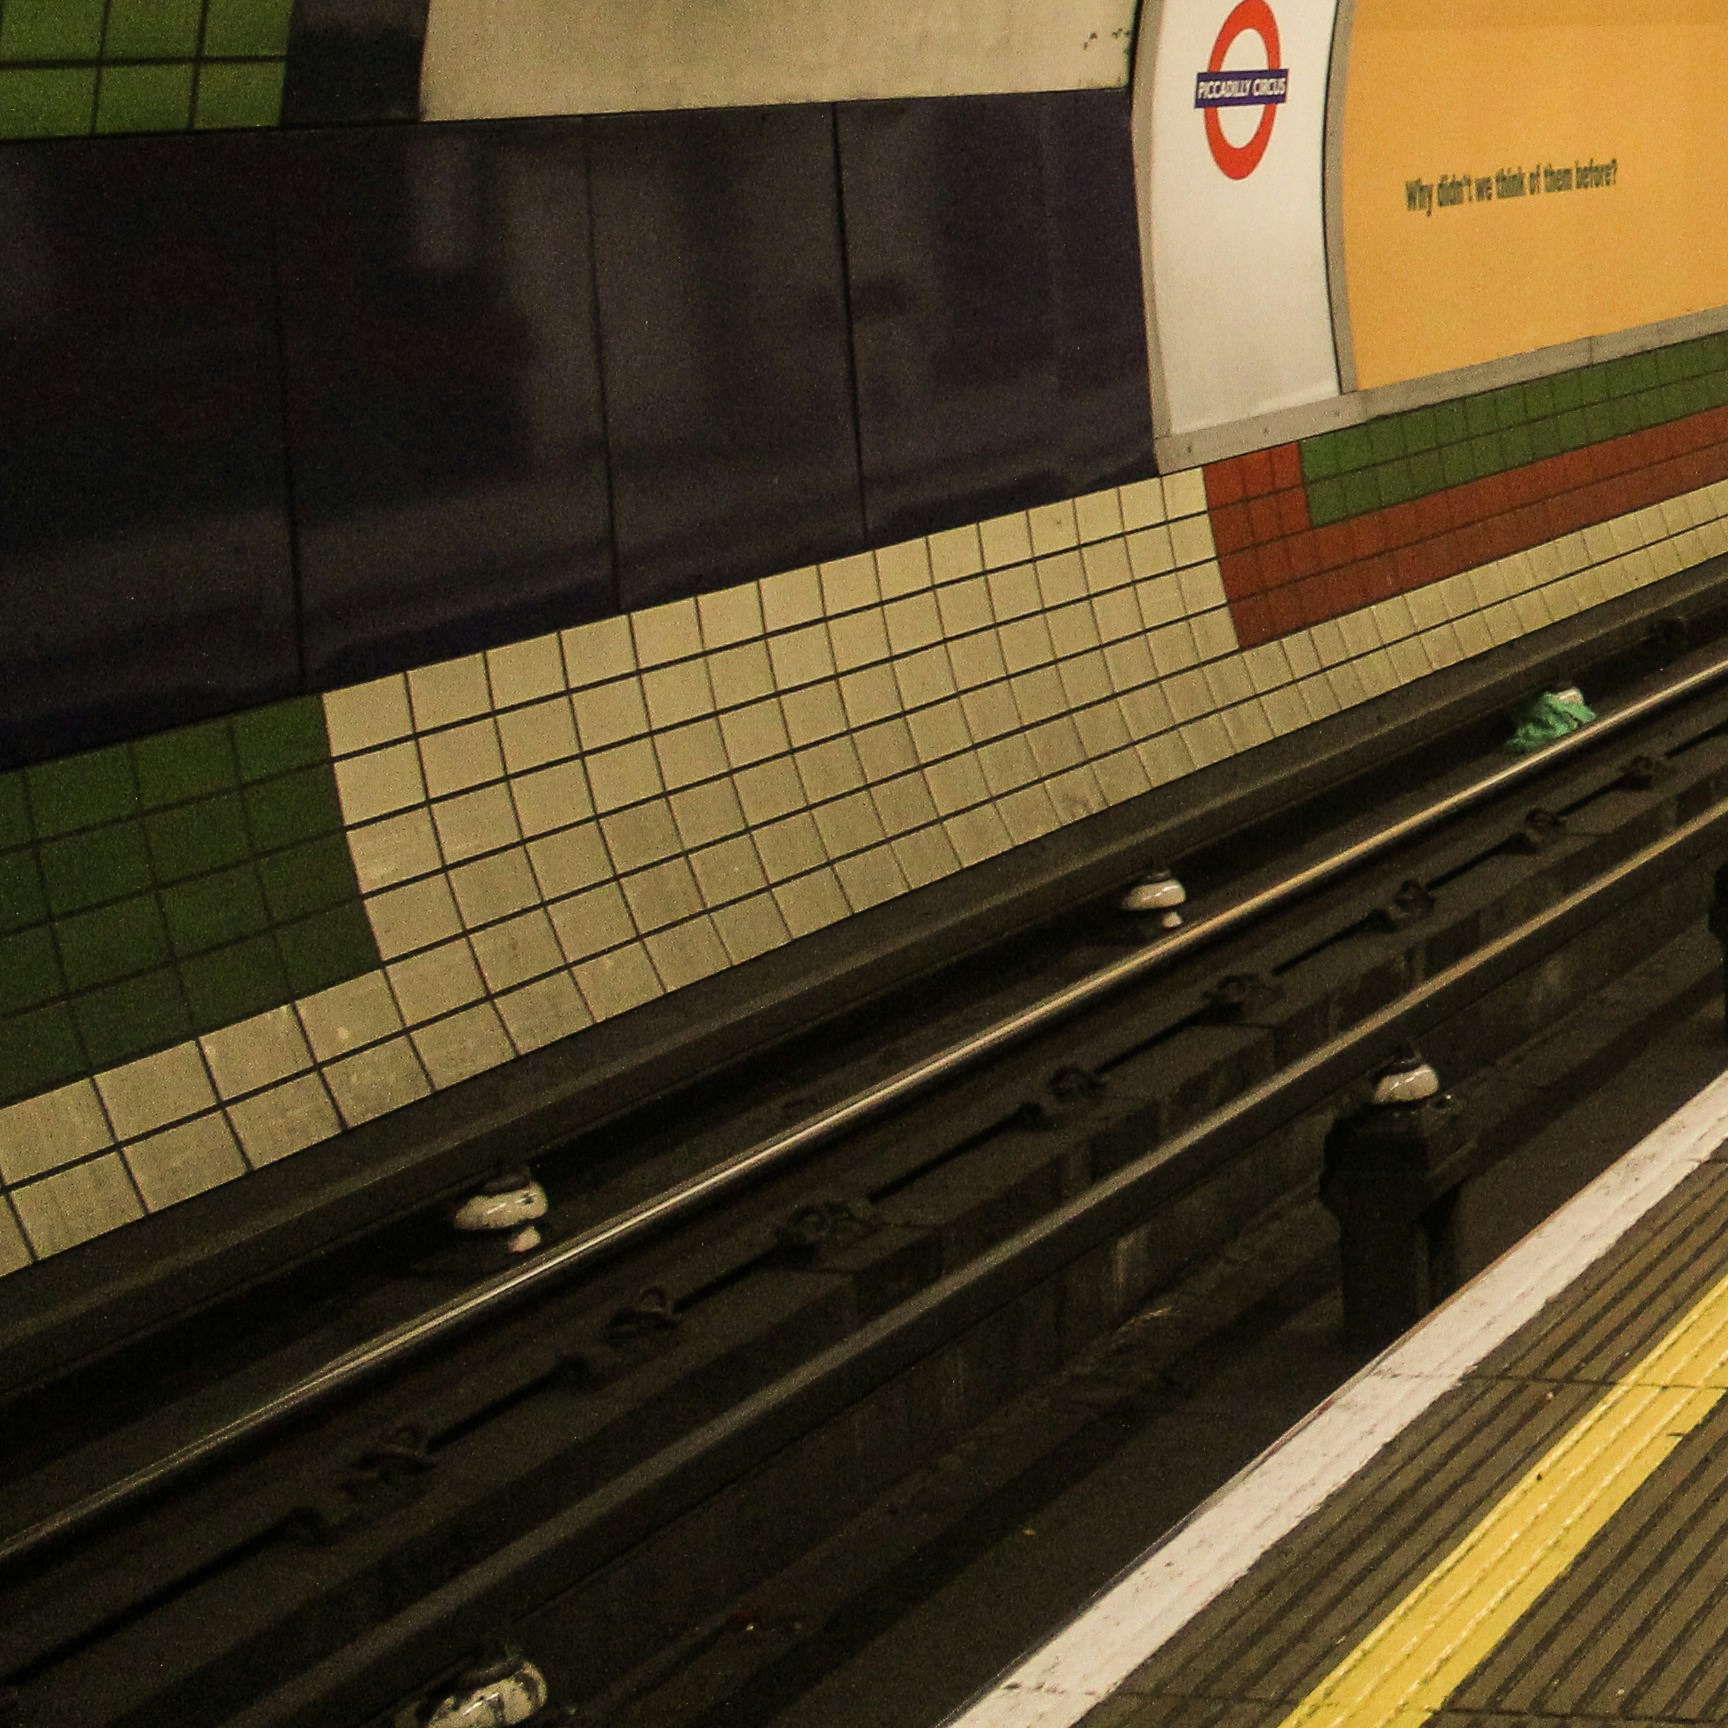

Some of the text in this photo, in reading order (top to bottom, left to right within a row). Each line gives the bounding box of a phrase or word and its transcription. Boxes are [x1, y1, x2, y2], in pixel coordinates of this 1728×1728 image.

[1198, 77, 1286, 100] PICCADILLY CIRCUS
[1405, 179, 1433, 217] Why
[1495, 166, 1527, 200] think
[1543, 163, 1574, 193] them
